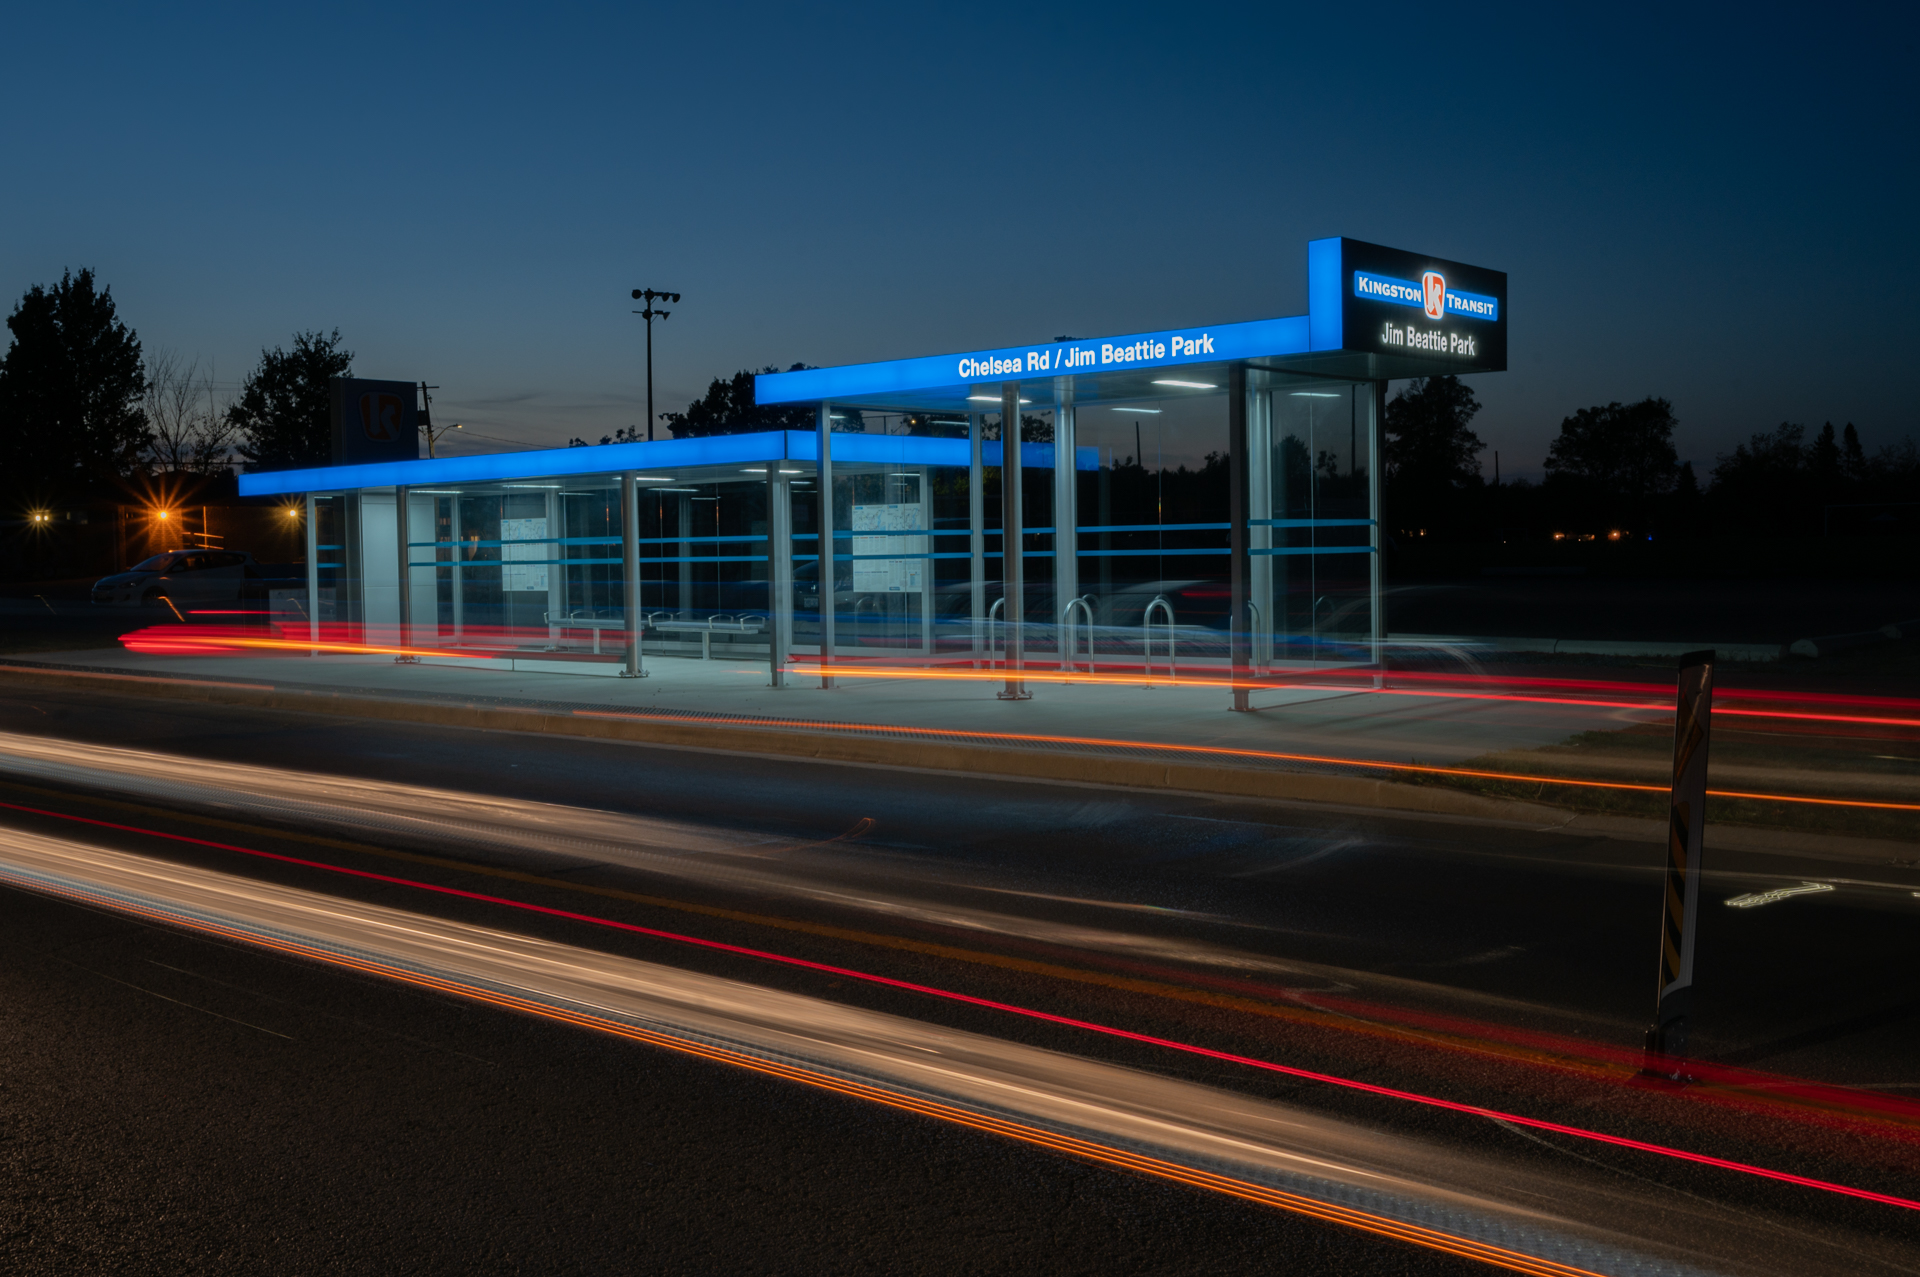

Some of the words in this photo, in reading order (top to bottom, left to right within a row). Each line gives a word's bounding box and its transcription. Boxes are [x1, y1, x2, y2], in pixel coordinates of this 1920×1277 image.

[1446, 294, 1494, 316] TRANSIT
[958, 356, 1022, 378] Chelsea
[1027, 350, 1050, 371] Rd
[1054, 349, 1062, 369] /
[1065, 347, 1096, 368] Jim
[1101, 341, 1166, 364] Beattie
[1172, 333, 1215, 357] Park
[1382, 322, 1404, 346] Jim
[1407, 326, 1448, 352] Beattie
[1450, 332, 1475, 356] Park
